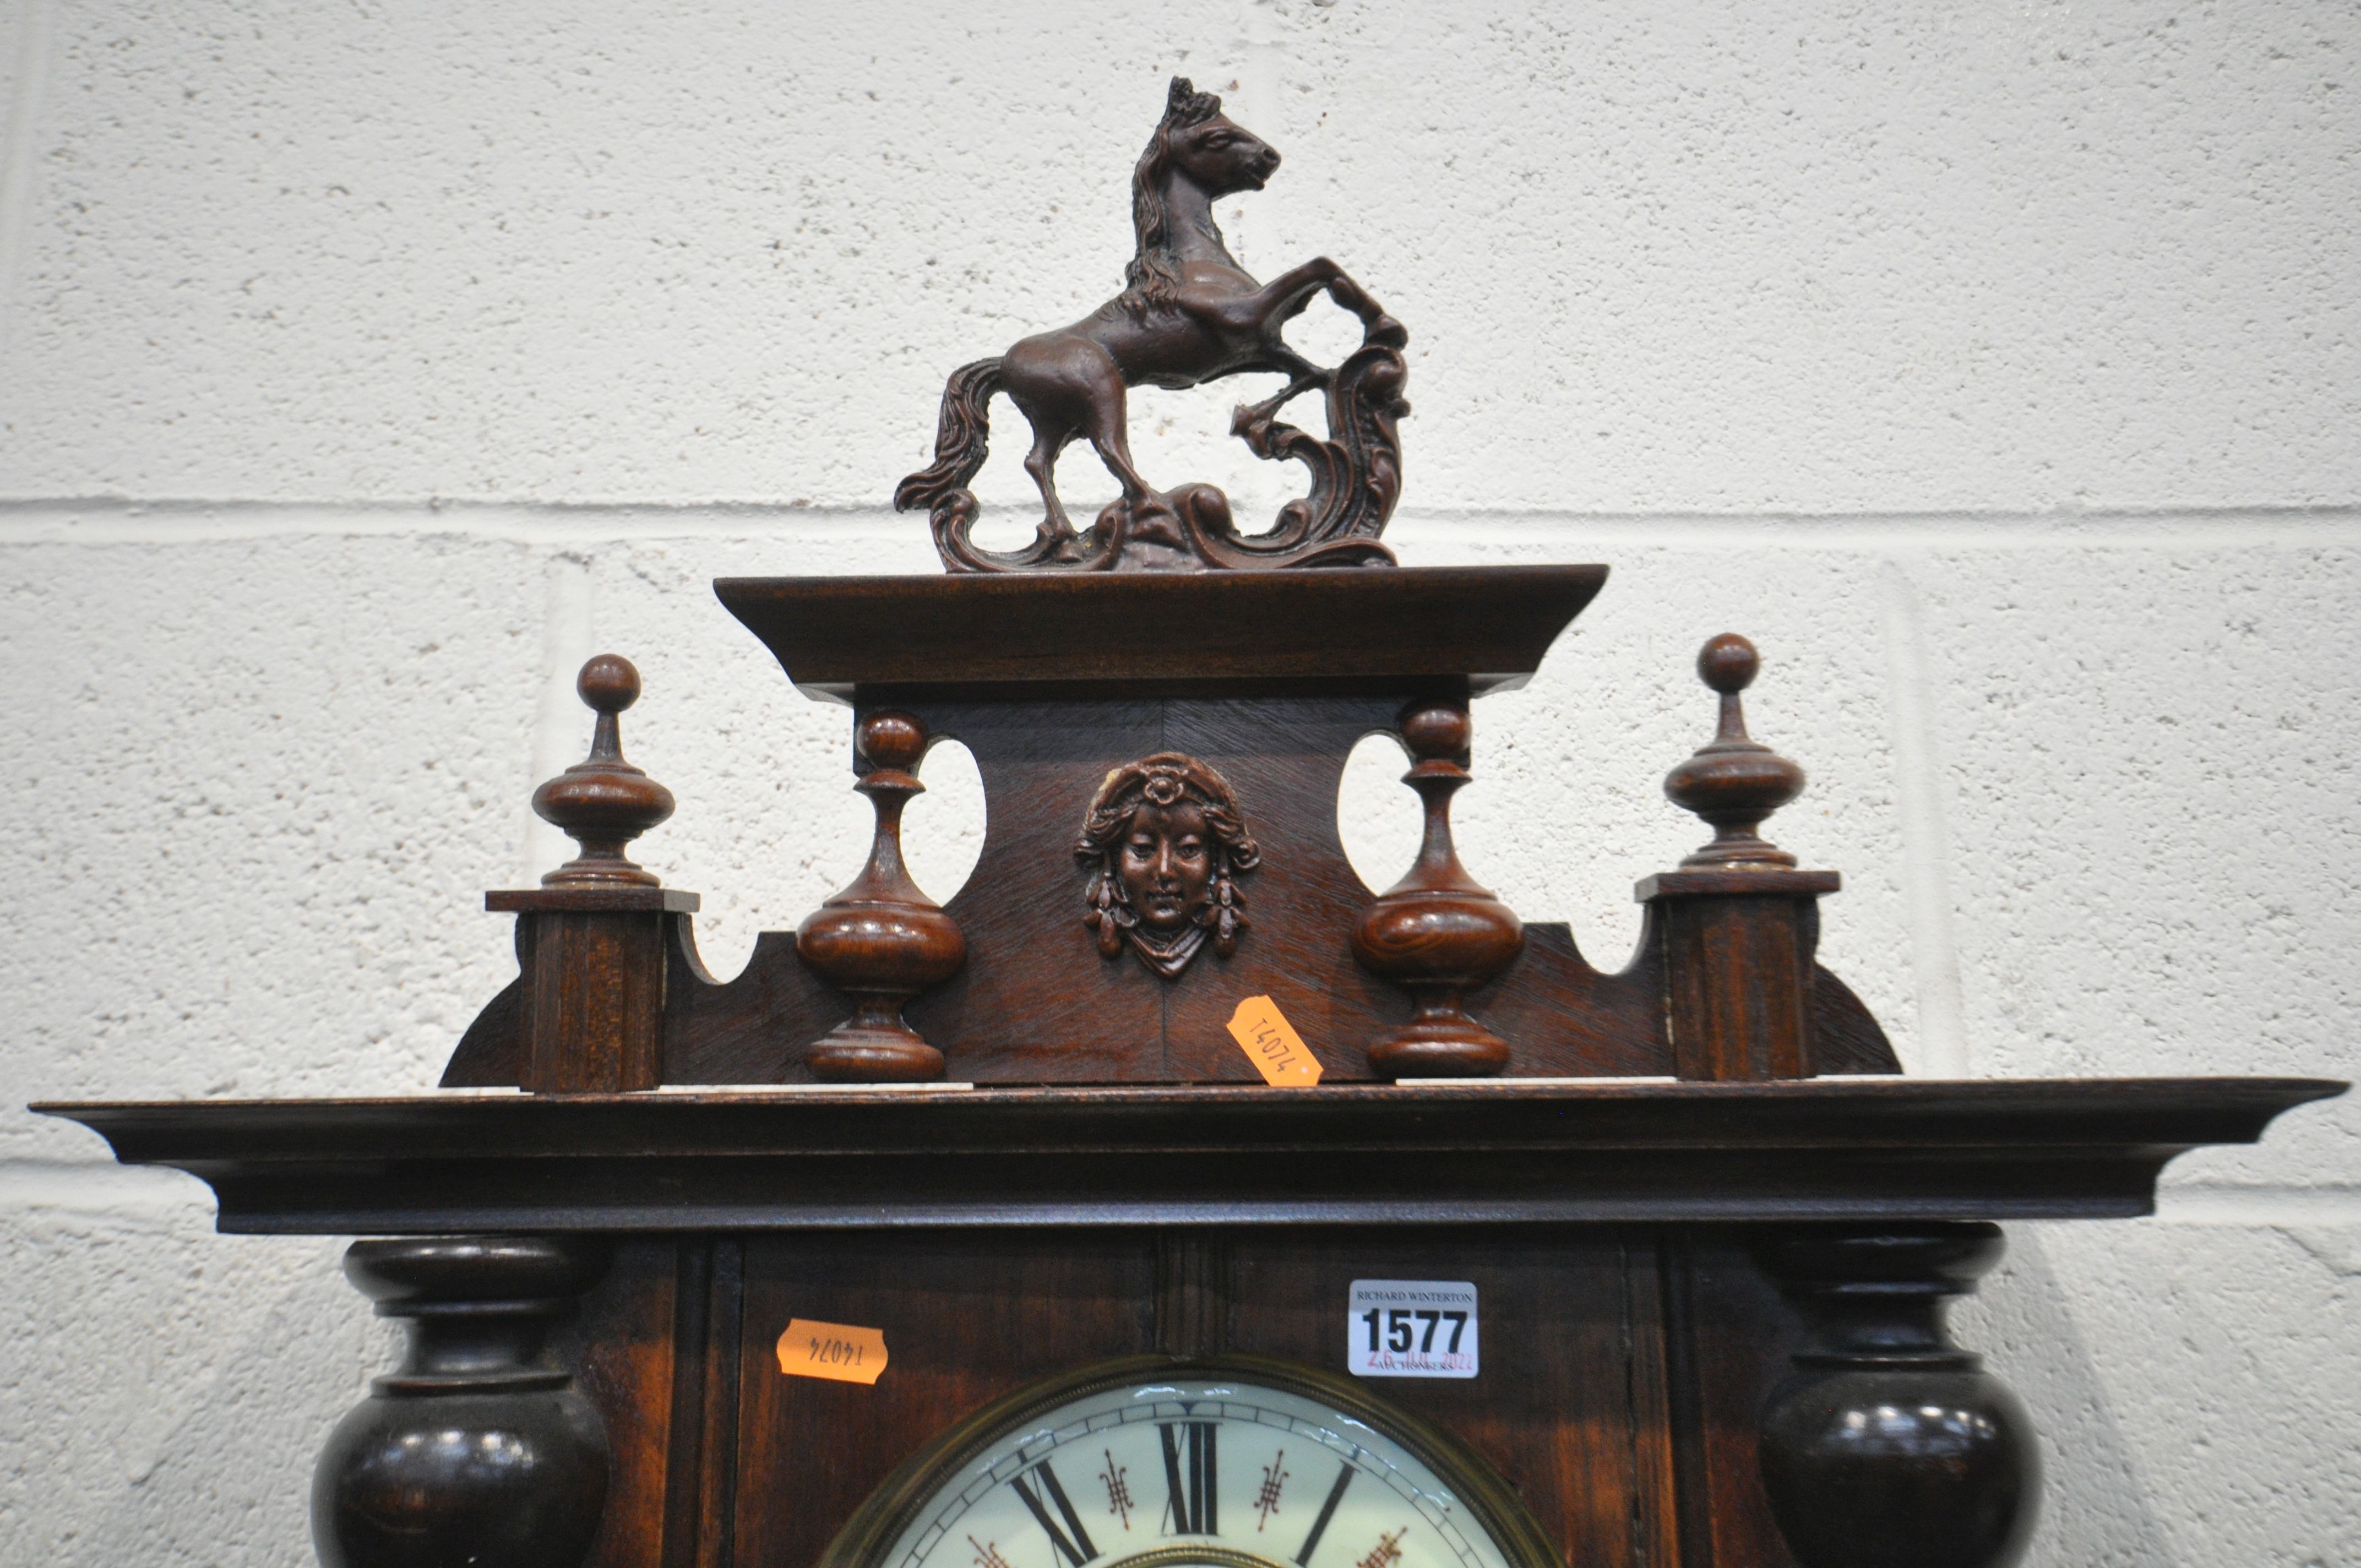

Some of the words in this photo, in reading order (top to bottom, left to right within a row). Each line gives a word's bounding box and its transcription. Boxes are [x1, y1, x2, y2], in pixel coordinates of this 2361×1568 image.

[1249, 1017, 1296, 1072] T4074
[1357, 1290, 1406, 1301] RICHARD
[1408, 1292, 1473, 1303] WINTERTON
[809, 1337, 863, 1366] T4074
[1362, 1308, 1468, 1353] 1577
[1154, 1420, 1222, 1537] XII
